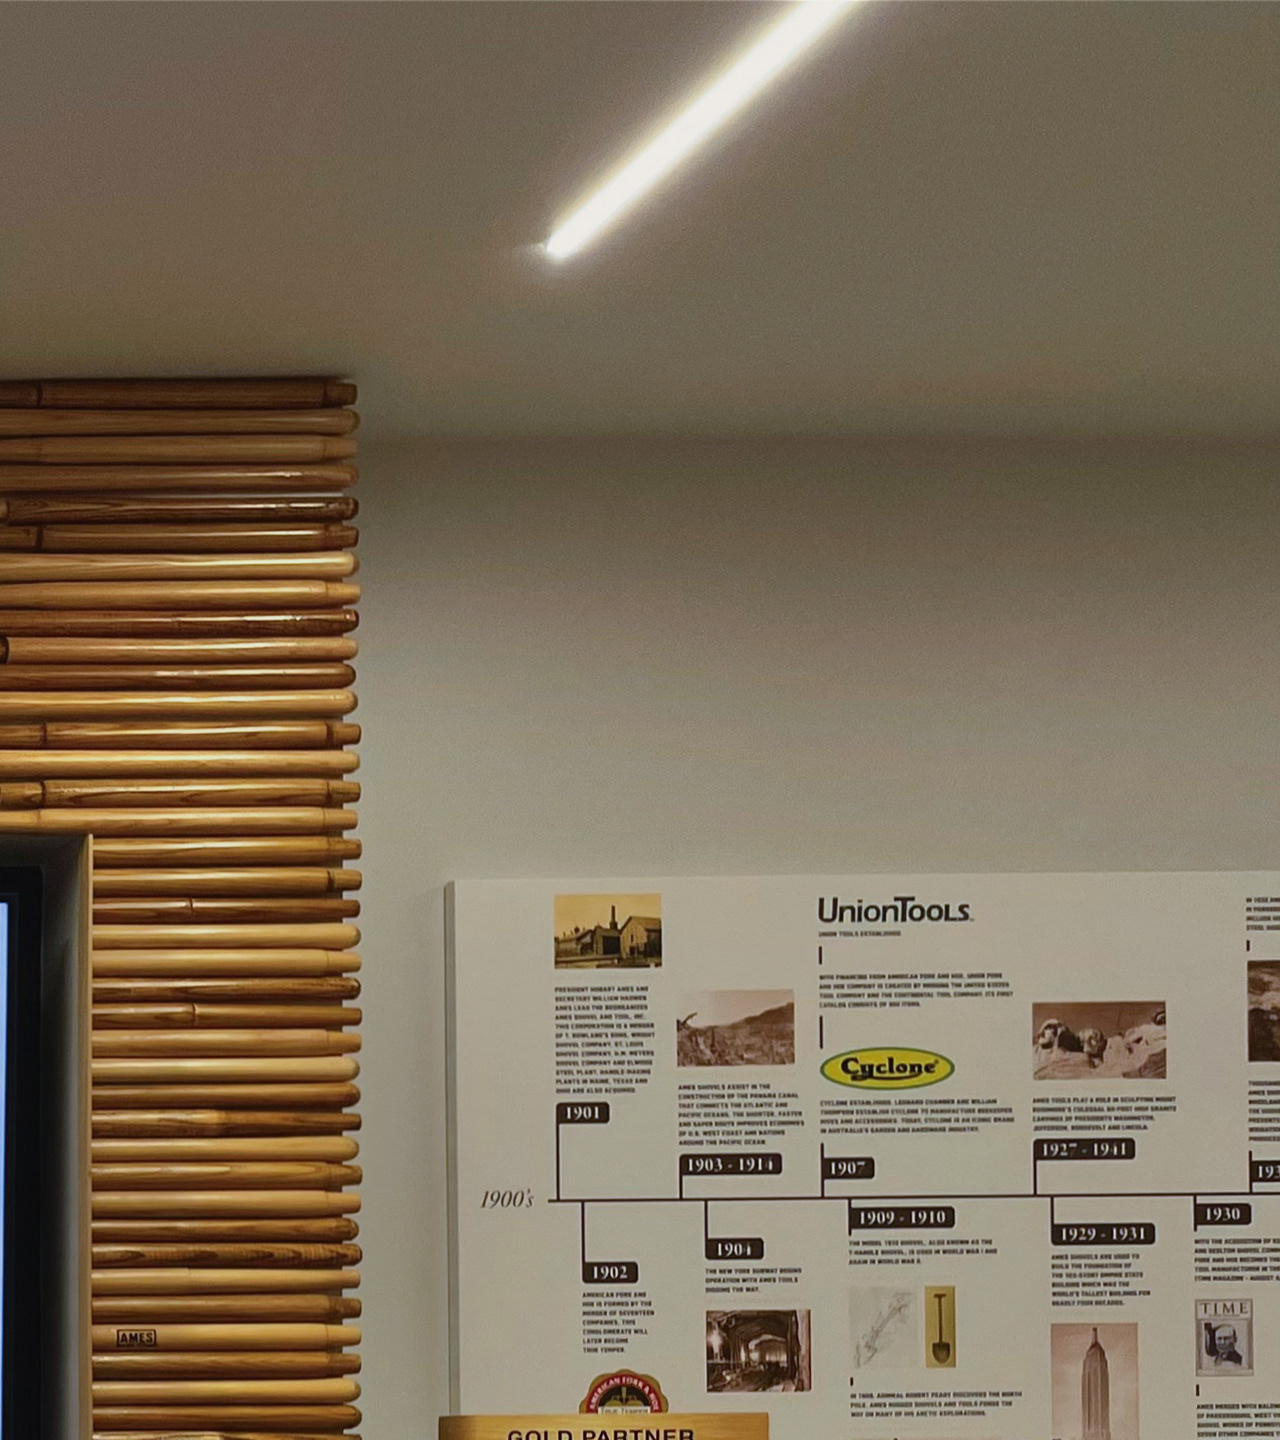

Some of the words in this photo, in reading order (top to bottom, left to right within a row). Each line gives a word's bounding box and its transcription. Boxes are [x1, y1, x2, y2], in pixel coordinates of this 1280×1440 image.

[840, 1057, 935, 1081] Cyclone
[565, 1106, 600, 1120] 1901
[1041, 1143, 1078, 1158] 1927
[1092, 1142, 1128, 1156] 1941
[687, 1158, 722, 1173] 1903
[739, 1157, 774, 1171] 1914
[829, 1161, 866, 1176] 1907
[481, 1189, 534, 1209] 1900's
[859, 1211, 895, 1225] 1909
[910, 1210, 946, 1225] 1910
[1205, 1207, 1241, 1221] 1930
[1060, 1227, 1096, 1242] 1929
[1112, 1226, 1146, 1241] 1931
[717, 1242, 752, 1257] 1904
[592, 1264, 628, 1280] 1902
[1201, 1302, 1248, 1314] TIME
[120, 1331, 154, 1344] AMES
[589, 1377, 620, 1411] AMERICAN
[622, 1376, 644, 1390] FORK
